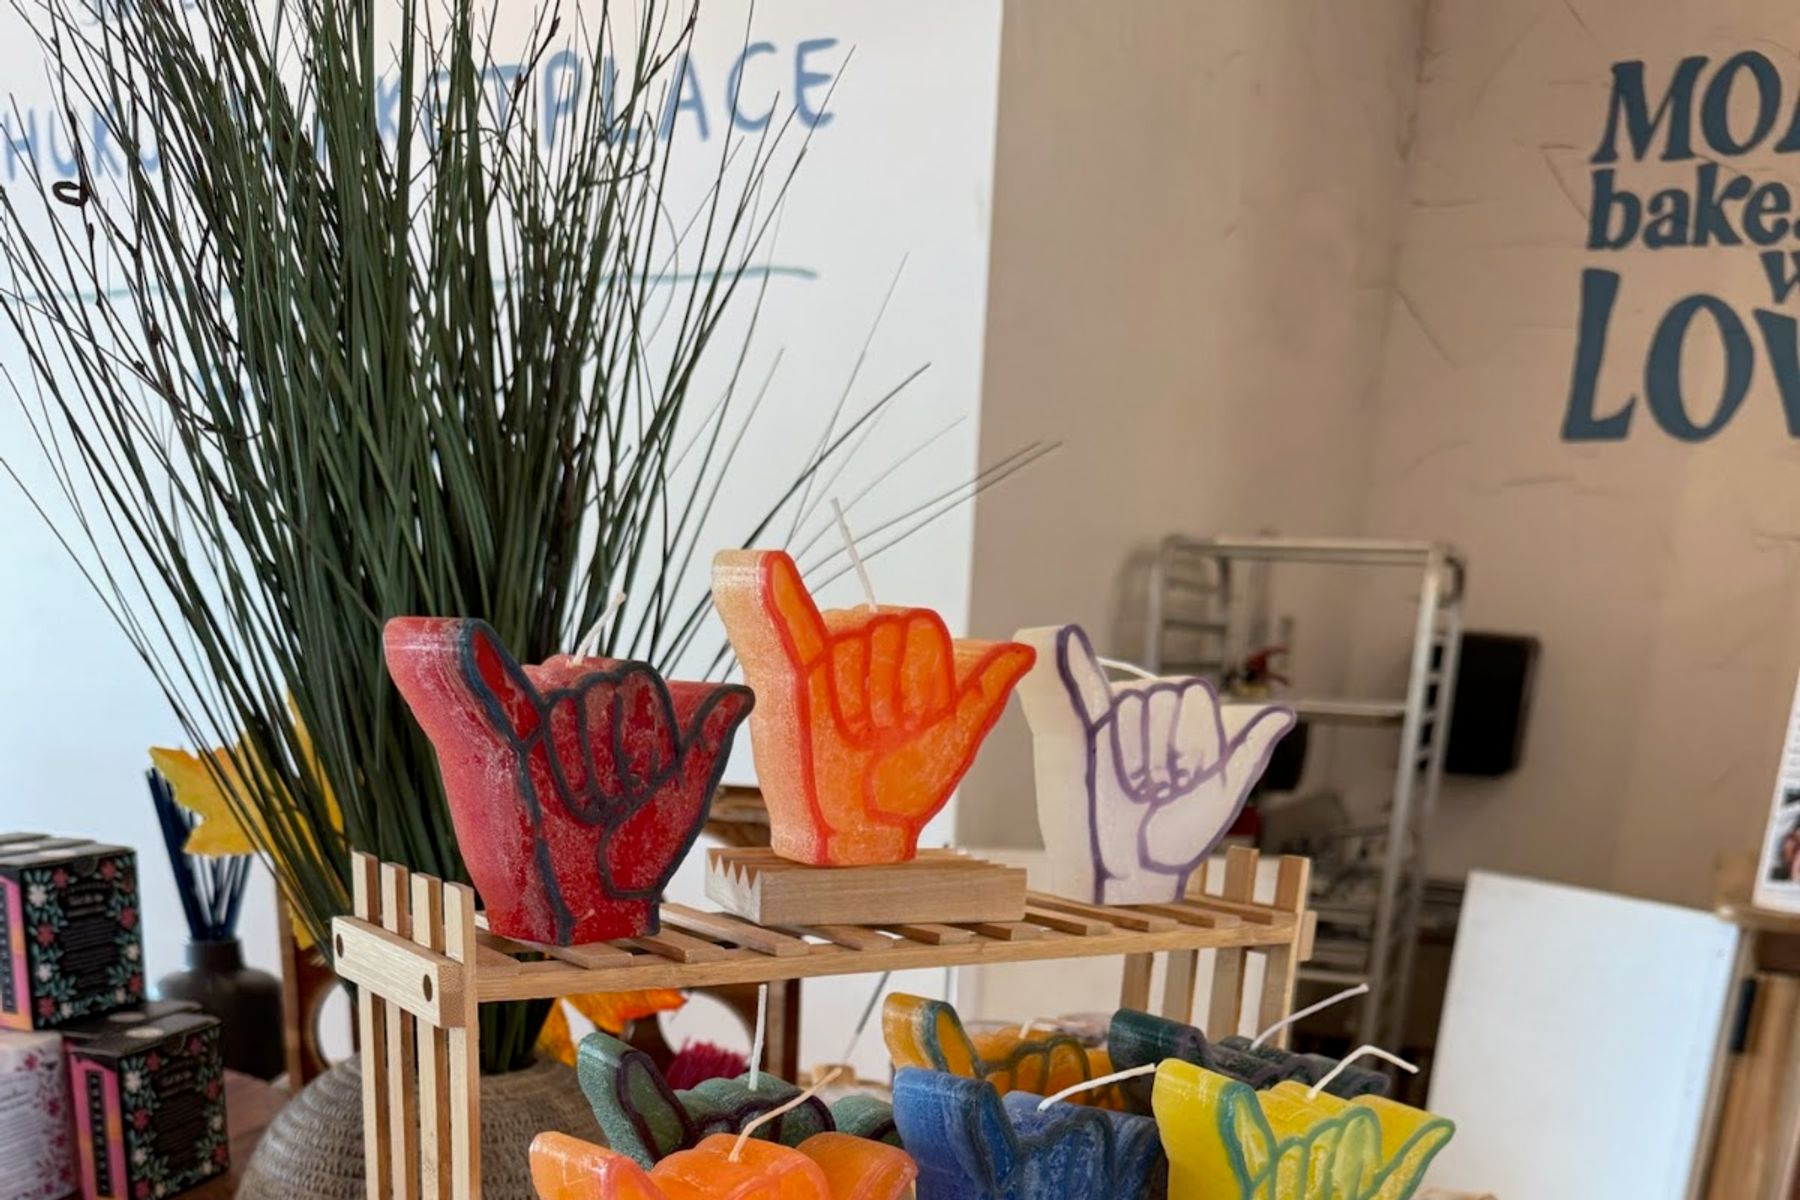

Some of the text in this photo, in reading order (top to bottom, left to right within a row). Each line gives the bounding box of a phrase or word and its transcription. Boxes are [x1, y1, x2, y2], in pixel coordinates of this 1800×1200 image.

[228, 38, 838, 163] KETPLACE
[1590, 50, 1800, 163] MO
[1587, 163, 1800, 249] bake
